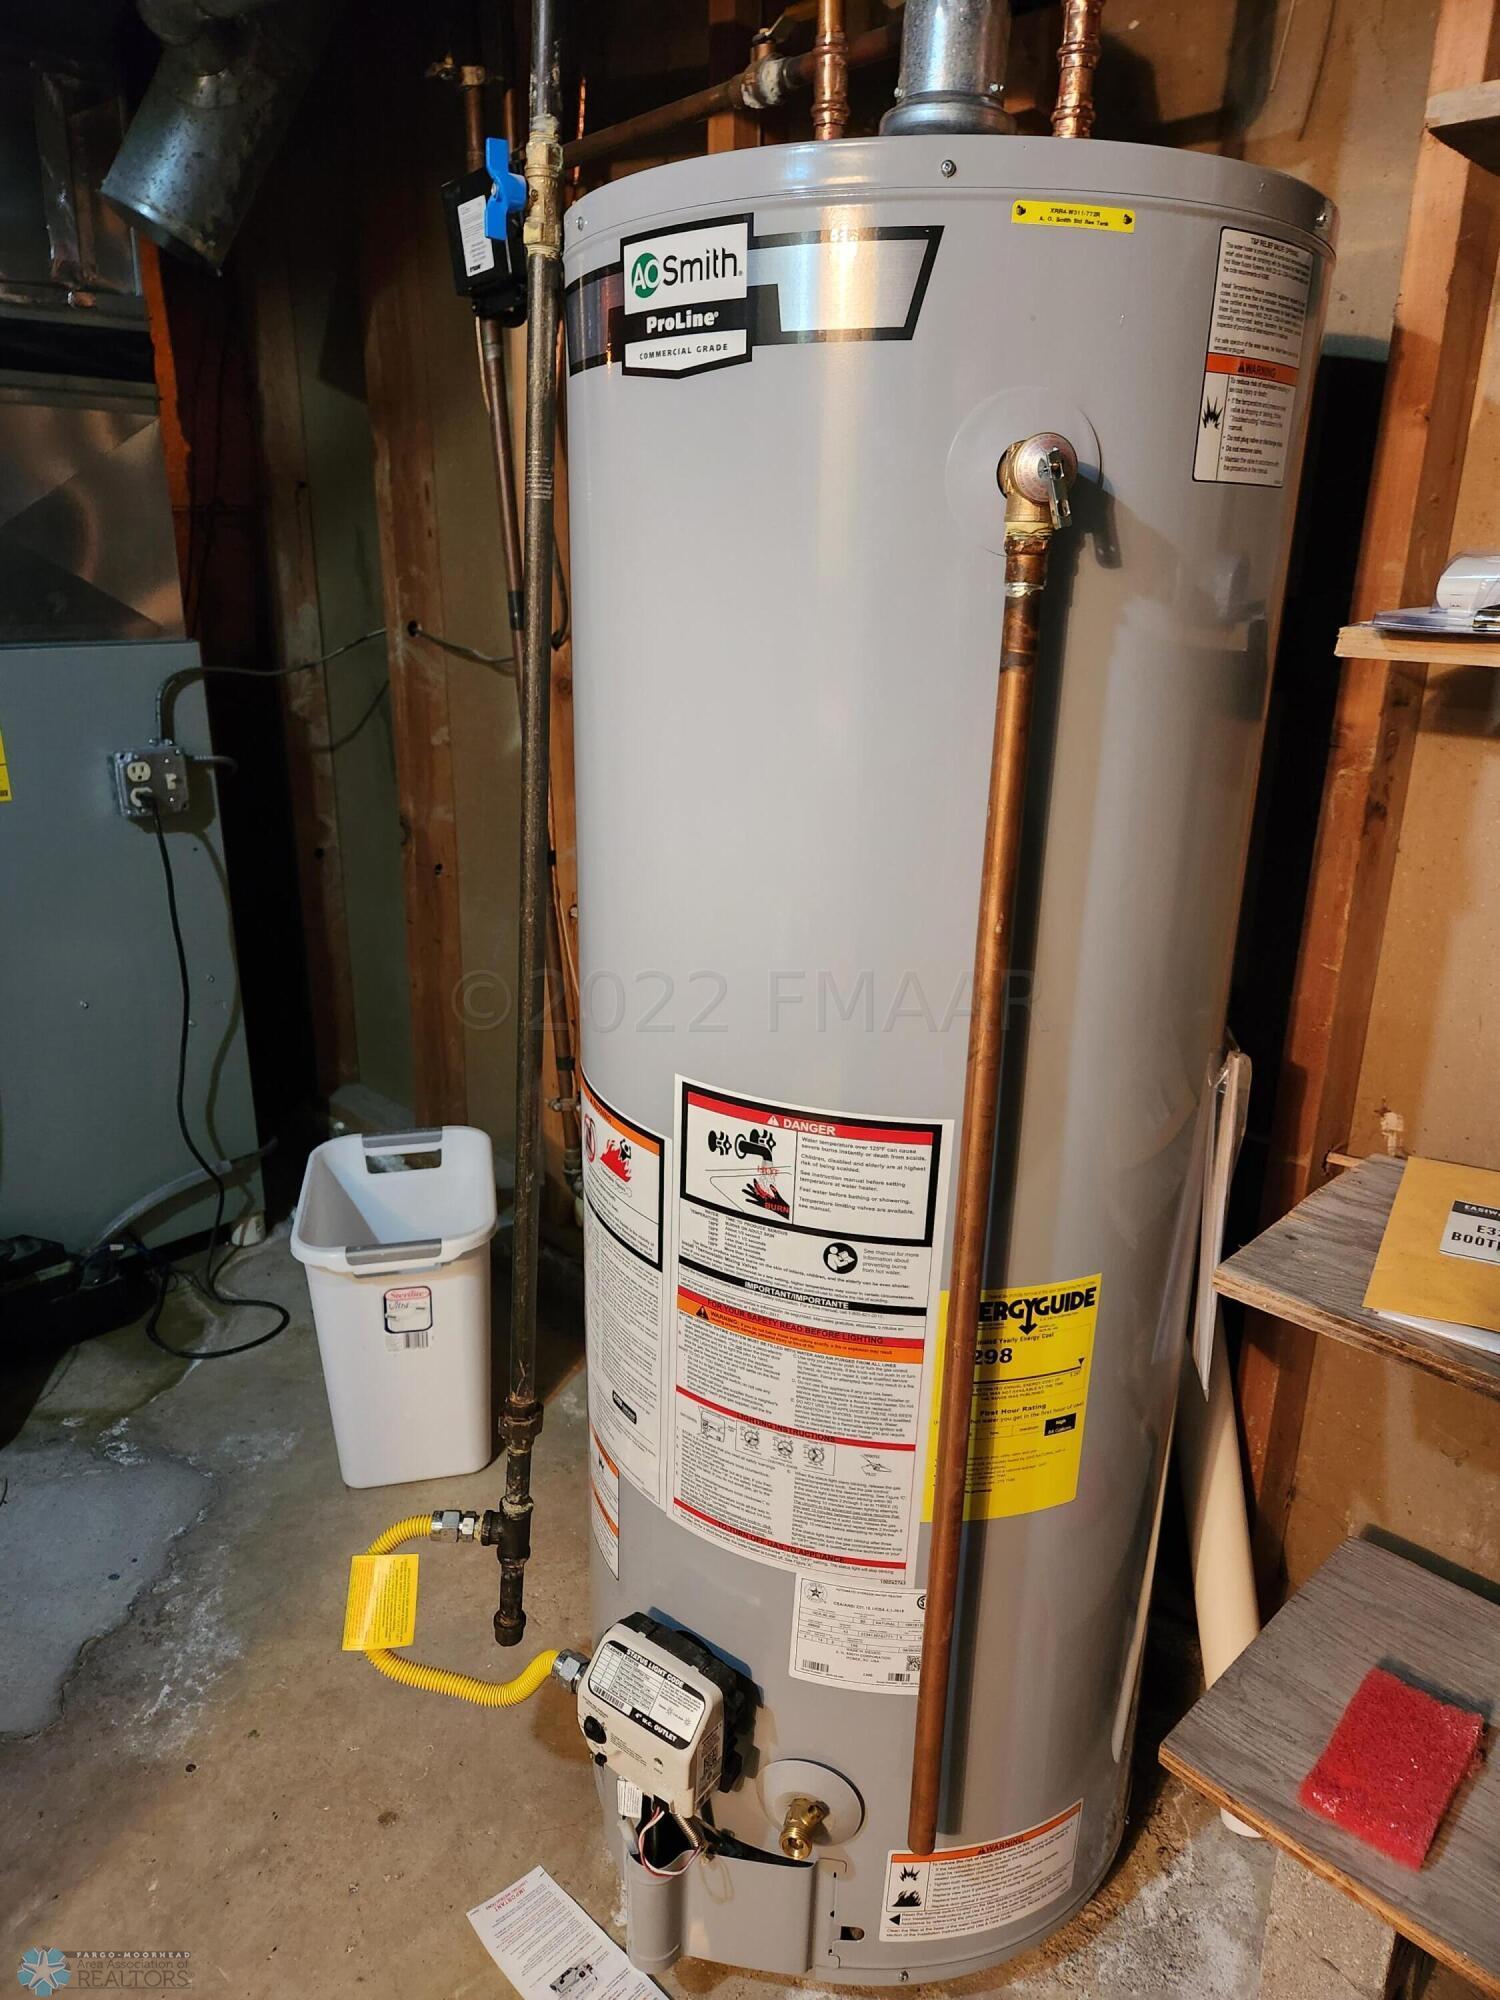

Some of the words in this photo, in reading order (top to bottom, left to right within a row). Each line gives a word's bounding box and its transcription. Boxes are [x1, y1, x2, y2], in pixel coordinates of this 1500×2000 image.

[662, 247, 738, 287] Smith
[646, 312, 715, 334] ProLine
[639, 348, 691, 360] COMMERCIAL
[696, 343, 728, 353] GRADE
[783, 1118, 836, 1136] DANGER
[819, 1140, 853, 1148] temperature
[801, 1153, 825, 1162] Children,
[840, 1149, 864, 1157] instantly
[800, 1177, 833, 1186] temperature
[812, 1172, 842, 1180] instruction
[799, 1196, 833, 1206] Temperature
[835, 1202, 856, 1210] limiting
[848, 1193, 870, 1202] bathing
[765, 1202, 789, 1213] BURN
[744, 1281, 849, 1310] IMPORTANT/IMPORTANTE
[708, 1299, 723, 1309] FOR
[724, 1303, 745, 1317] YOUR
[747, 1311, 778, 1326] SAFETY
[779, 1320, 802, 1333] READ
[805, 1326, 840, 1340] BEFORE
[843, 1332, 884, 1344] LIGHTING
[1022, 1404, 1046, 1412] Rating
[775, 1424, 835, 1442] INSTRUCTIONS
[626, 1648, 649, 1665] STATUS
[649, 1661, 667, 1677] LIGHT
[667, 1673, 684, 1688] CODE
[653, 1723, 677, 1742] OUTLET
[986, 1835, 1024, 1854] WARNING
